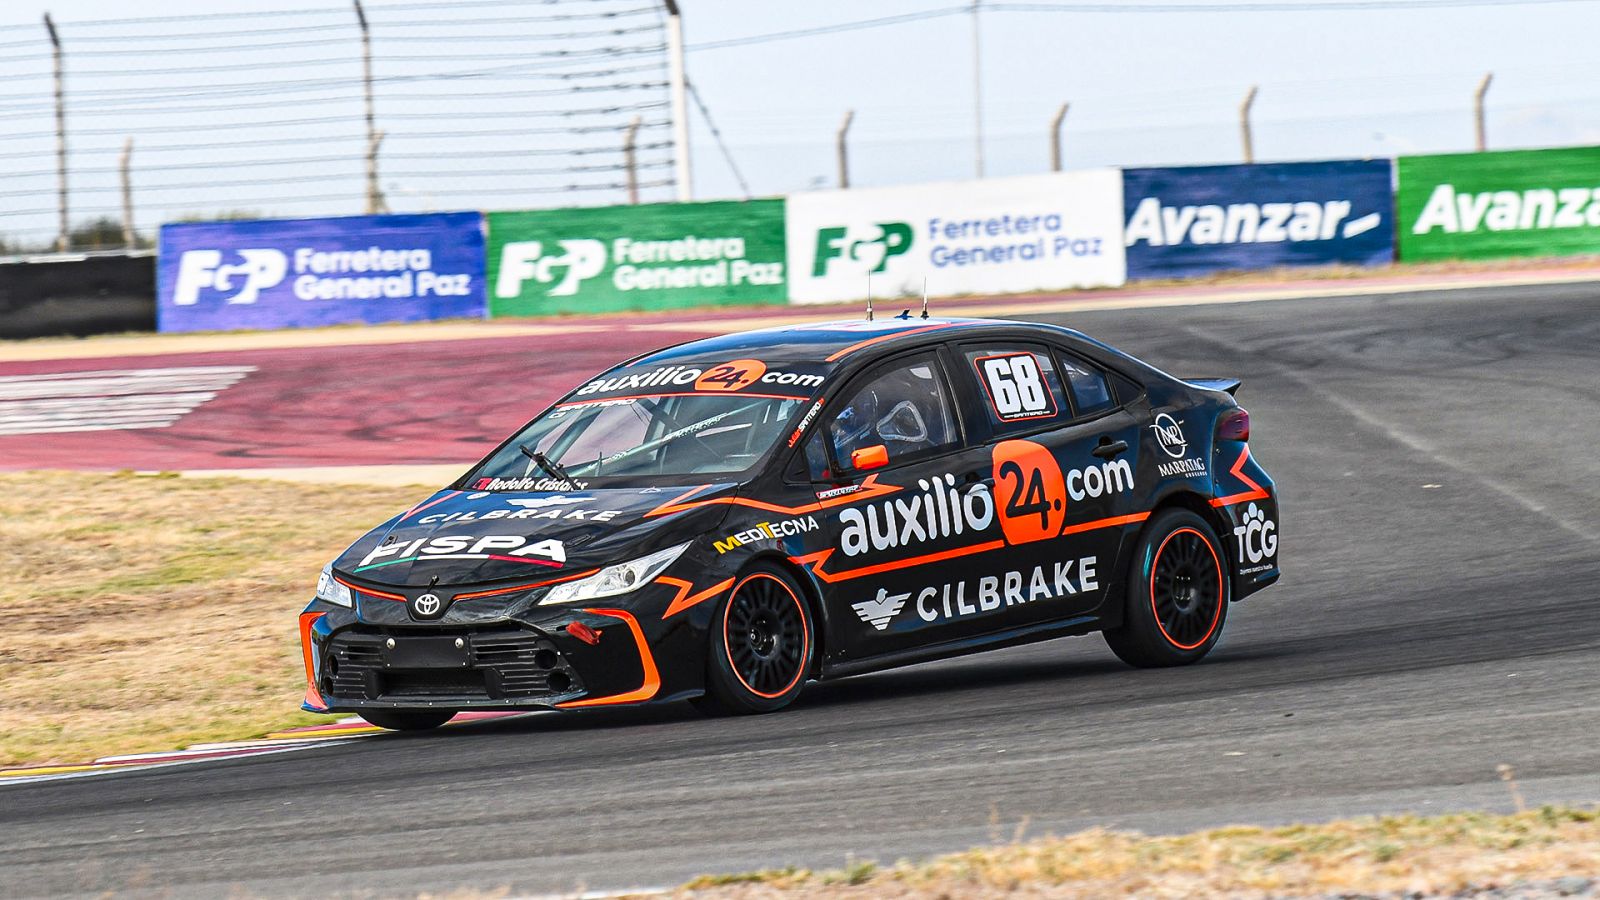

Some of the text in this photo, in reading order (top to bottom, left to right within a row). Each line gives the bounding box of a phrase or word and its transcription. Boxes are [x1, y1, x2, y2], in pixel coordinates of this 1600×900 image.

[928, 213, 1063, 241] Ferretera
[1125, 197, 1351, 247] Avanzar
[294, 246, 431, 273] Ferretera
[612, 235, 745, 263] Ferretera
[930, 235, 1103, 268] General Paz
[294, 270, 471, 300] General Paz
[612, 259, 784, 291] General Paz
[984, 355, 1047, 414] 68
[1158, 457, 1205, 477] MARPATAG
[485, 477, 535, 491] Rodolfo
[418, 510, 623, 524] CILBRAKE
[359, 535, 567, 567] FISPA
[713, 515, 819, 555] MEDITECNA
[1233, 519, 1278, 563] TCG
[916, 556, 1099, 622] CILBRAKE
